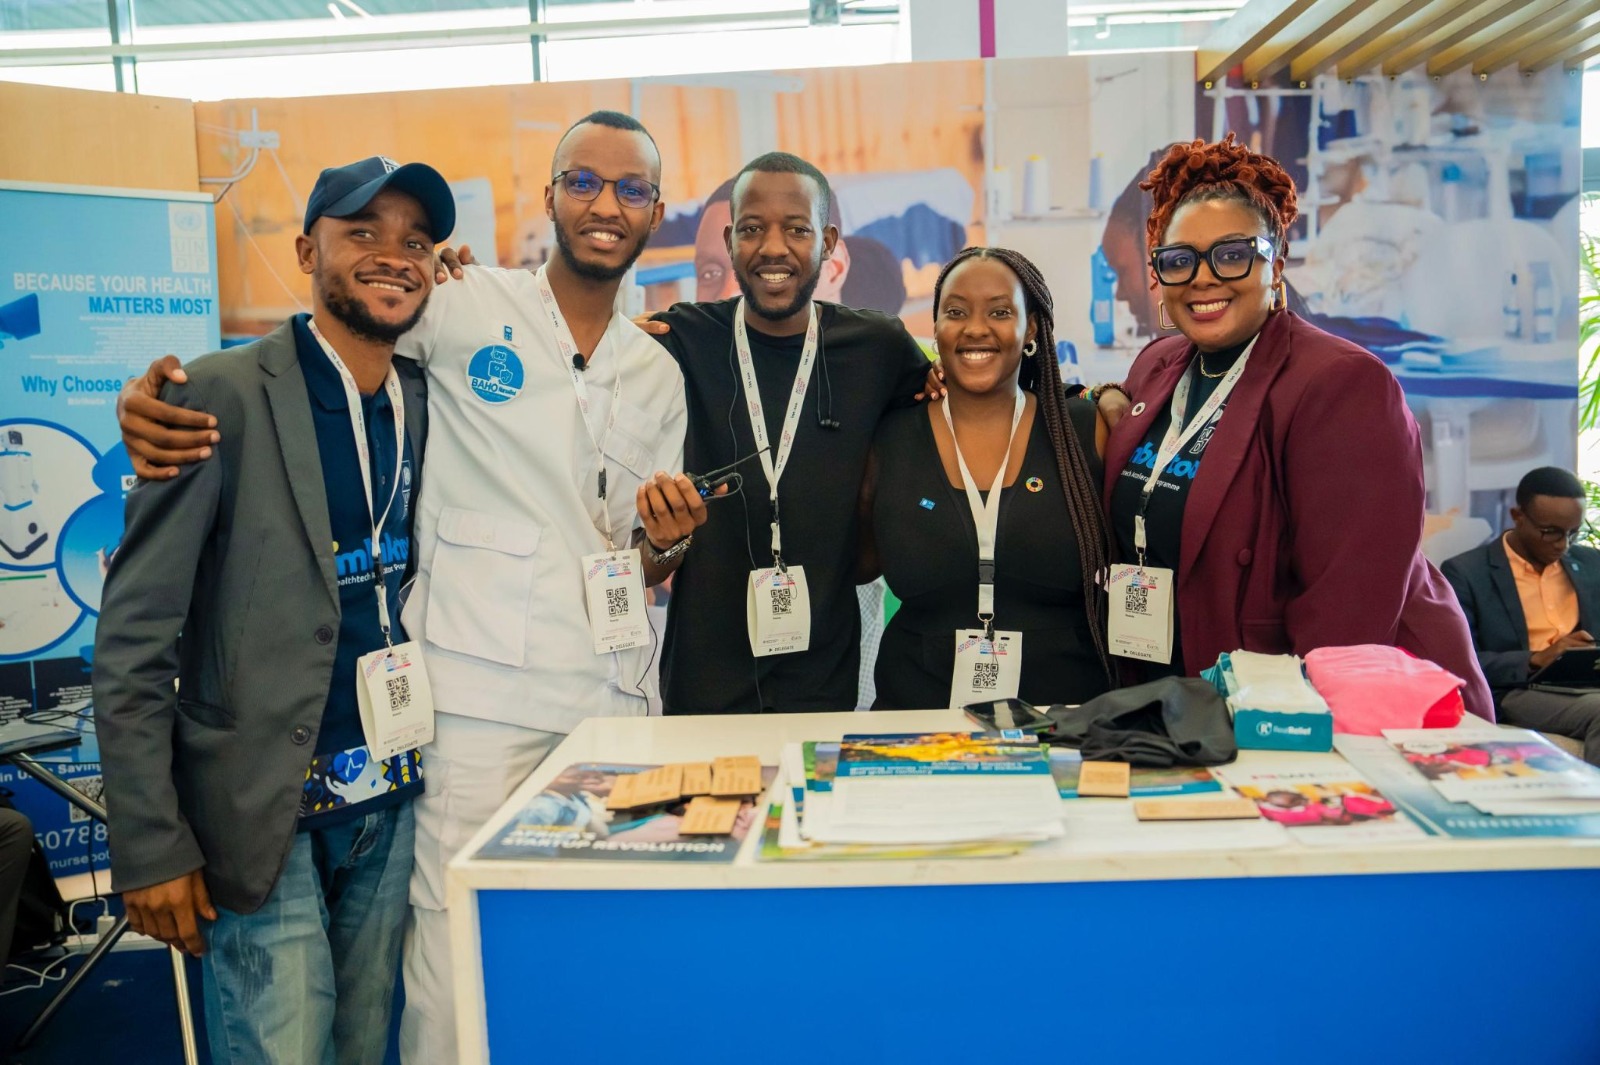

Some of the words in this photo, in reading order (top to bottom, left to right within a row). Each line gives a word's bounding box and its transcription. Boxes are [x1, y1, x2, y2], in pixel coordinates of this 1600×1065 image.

[13, 273, 96, 291] BECAUSE
[101, 275, 147, 293] YOUR
[152, 277, 212, 295] HEALTH
[89, 296, 164, 314] MATTERS
[169, 298, 212, 315] MOST
[21, 375, 57, 397] Why
[63, 375, 122, 392] Choose
[471, 378, 498, 392] BAHO
[501, 837, 591, 849] STARTUP
[592, 840, 725, 853] REVOLUTION
